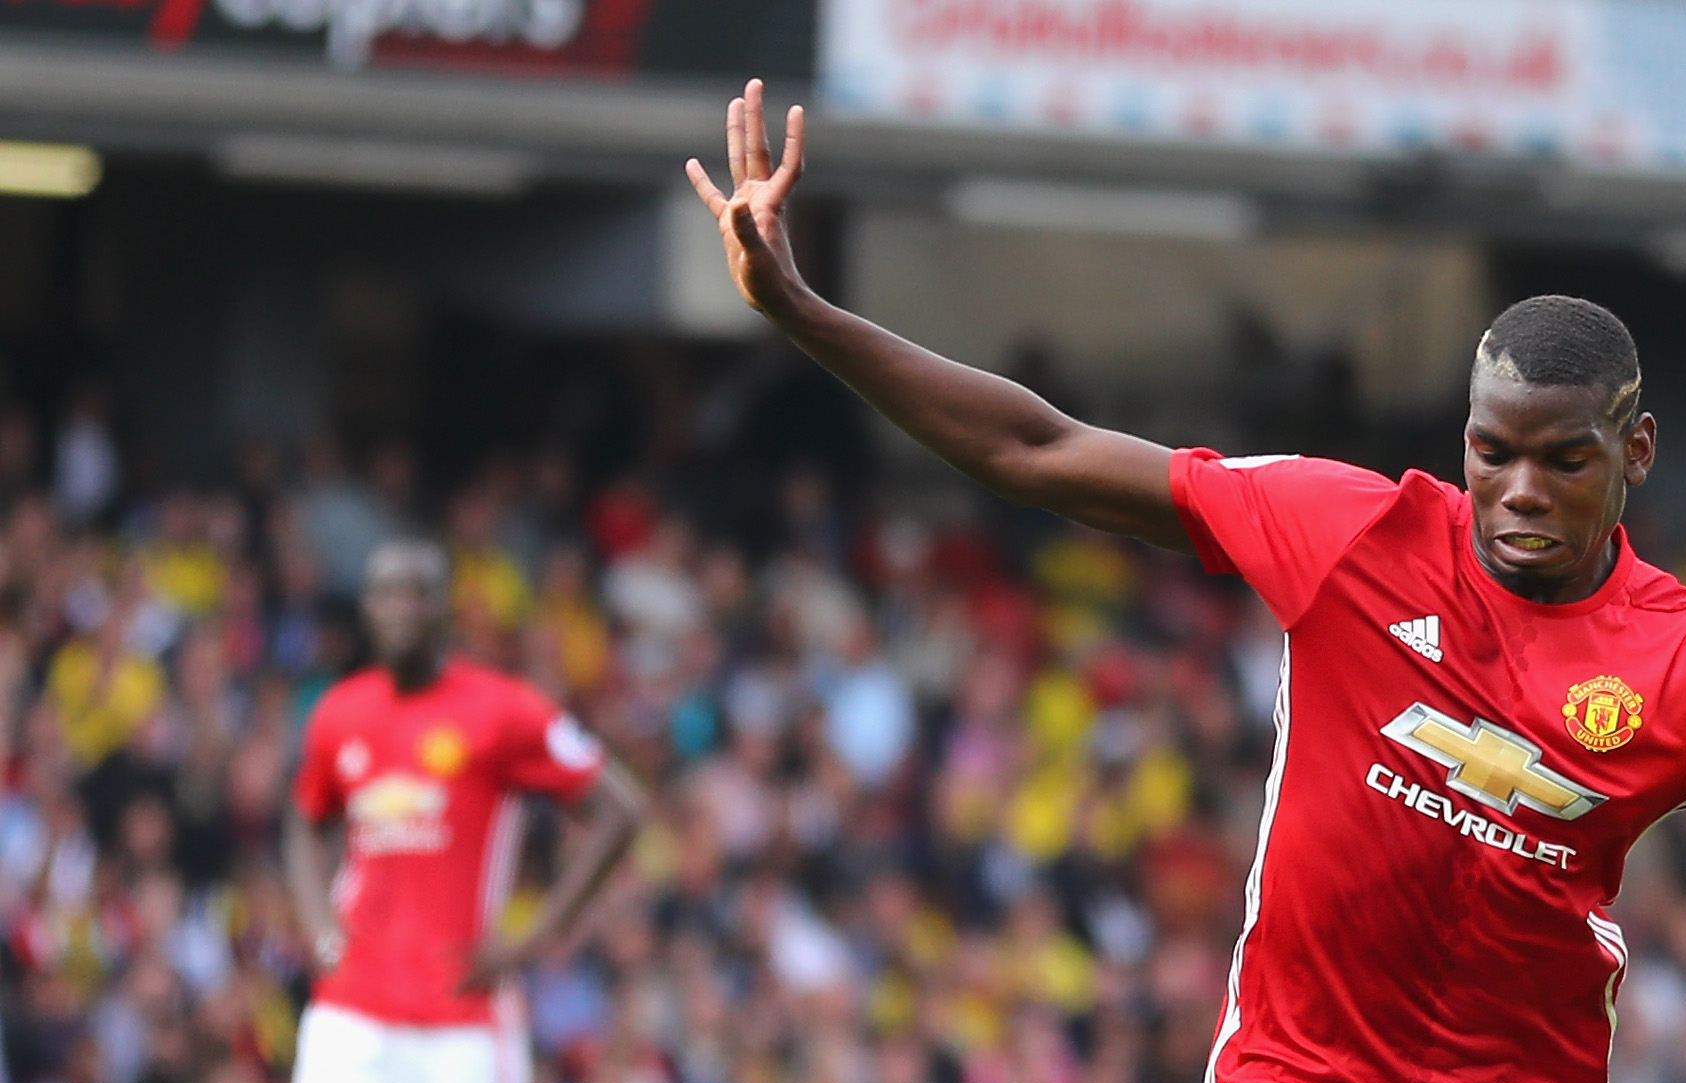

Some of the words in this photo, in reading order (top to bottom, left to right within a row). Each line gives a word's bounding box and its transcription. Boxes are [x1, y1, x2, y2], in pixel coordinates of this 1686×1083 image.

[1388, 623, 1444, 663] adidas
[1573, 680, 1638, 709] MANCHESTER
[1576, 729, 1621, 747] UNITED
[1365, 763, 1577, 870] CHEVROLET
